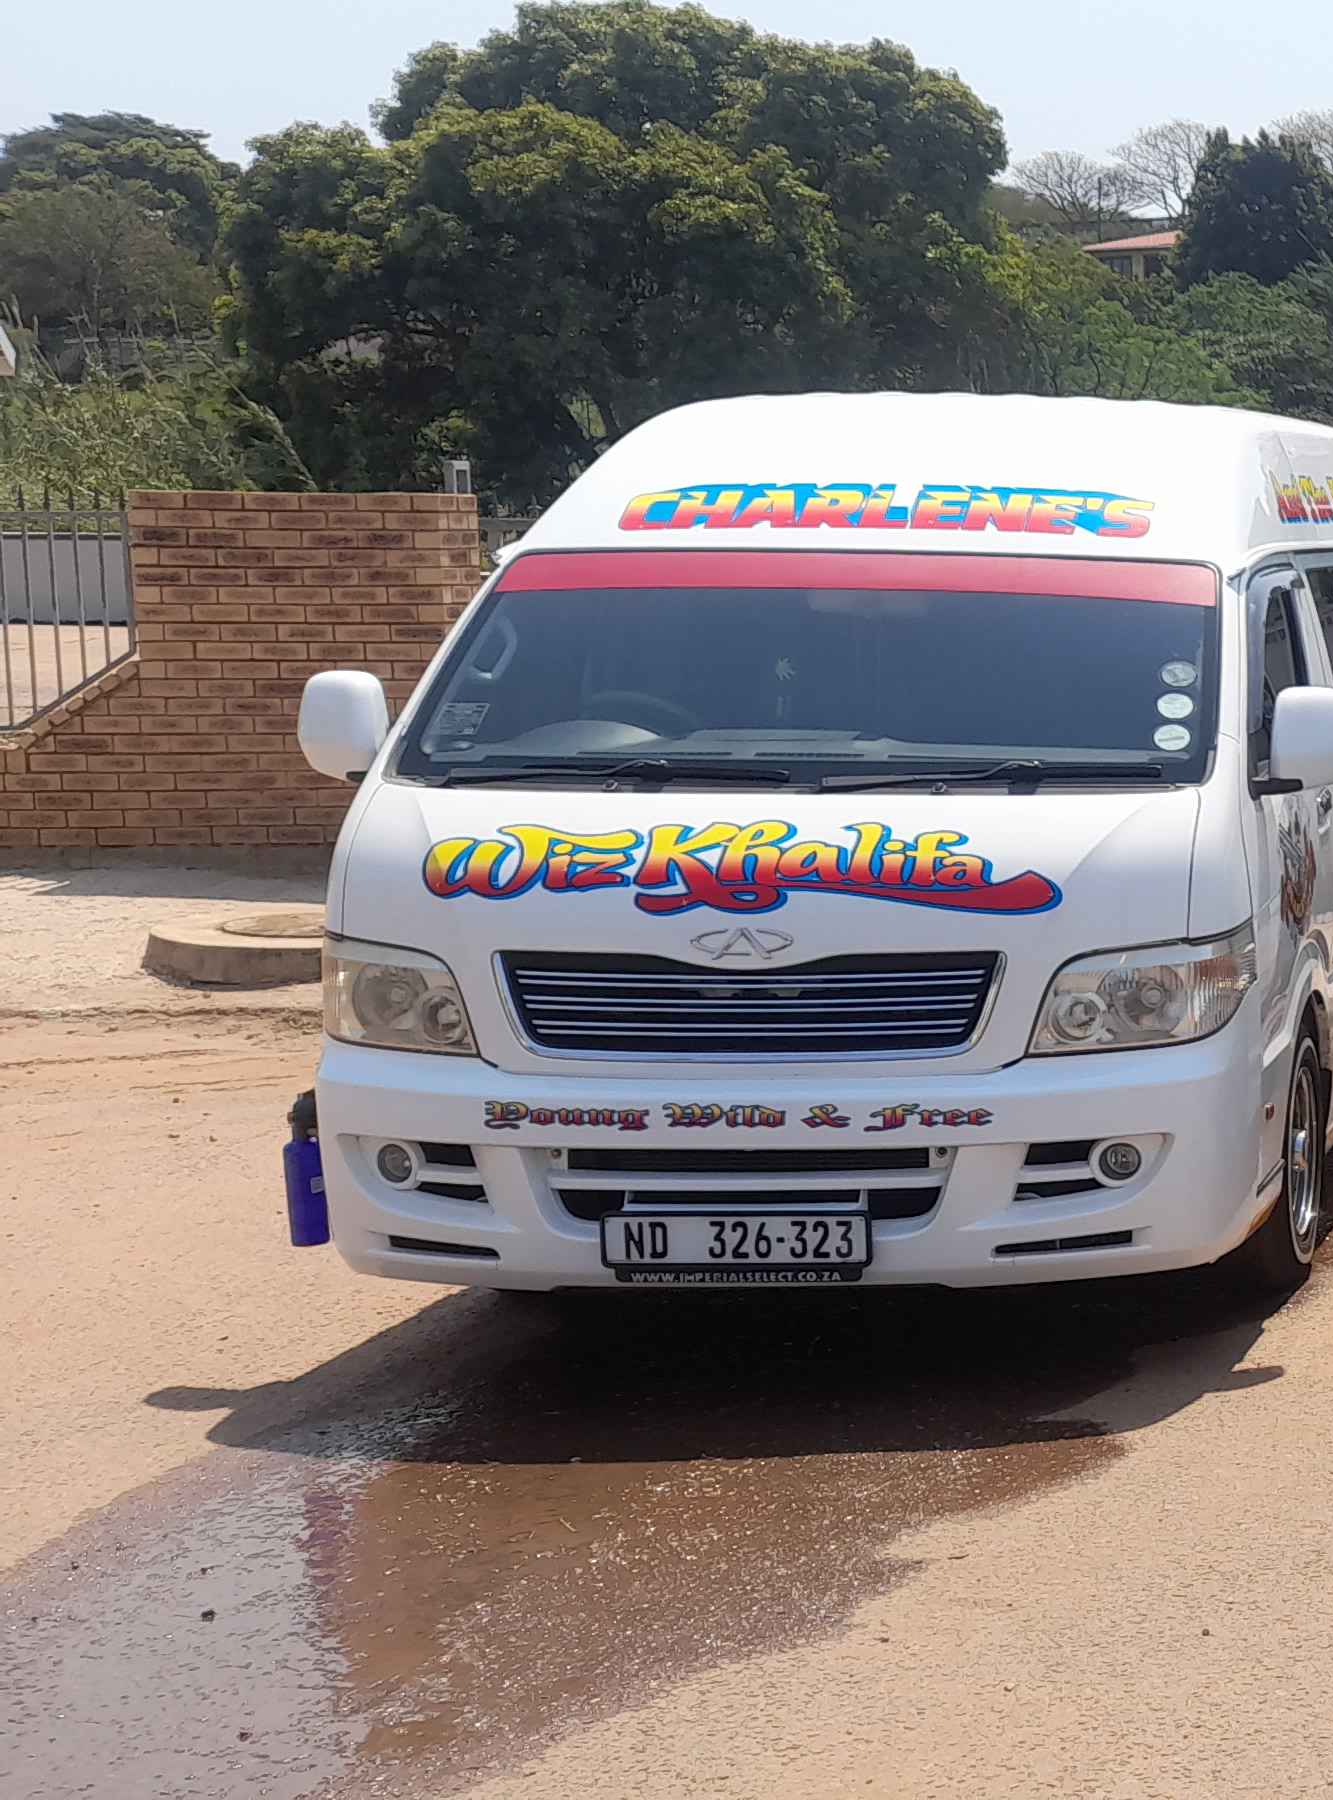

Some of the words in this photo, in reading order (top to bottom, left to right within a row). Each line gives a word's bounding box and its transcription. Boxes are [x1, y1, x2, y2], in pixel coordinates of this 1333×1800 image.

[618, 483, 1156, 538] CHARLENE'S
[422, 818, 645, 900] Wiz
[633, 819, 1064, 917] Khalifa
[484, 1100, 649, 1131] Young
[662, 1102, 787, 1129] Wild
[800, 1103, 850, 1128] &
[864, 1103, 995, 1132] Free
[623, 1221, 669, 1260] ND
[708, 1220, 853, 1259] 326-323
[630, 1271, 841, 1283] WWW.IMPERIALSELECT.CO.ZA
